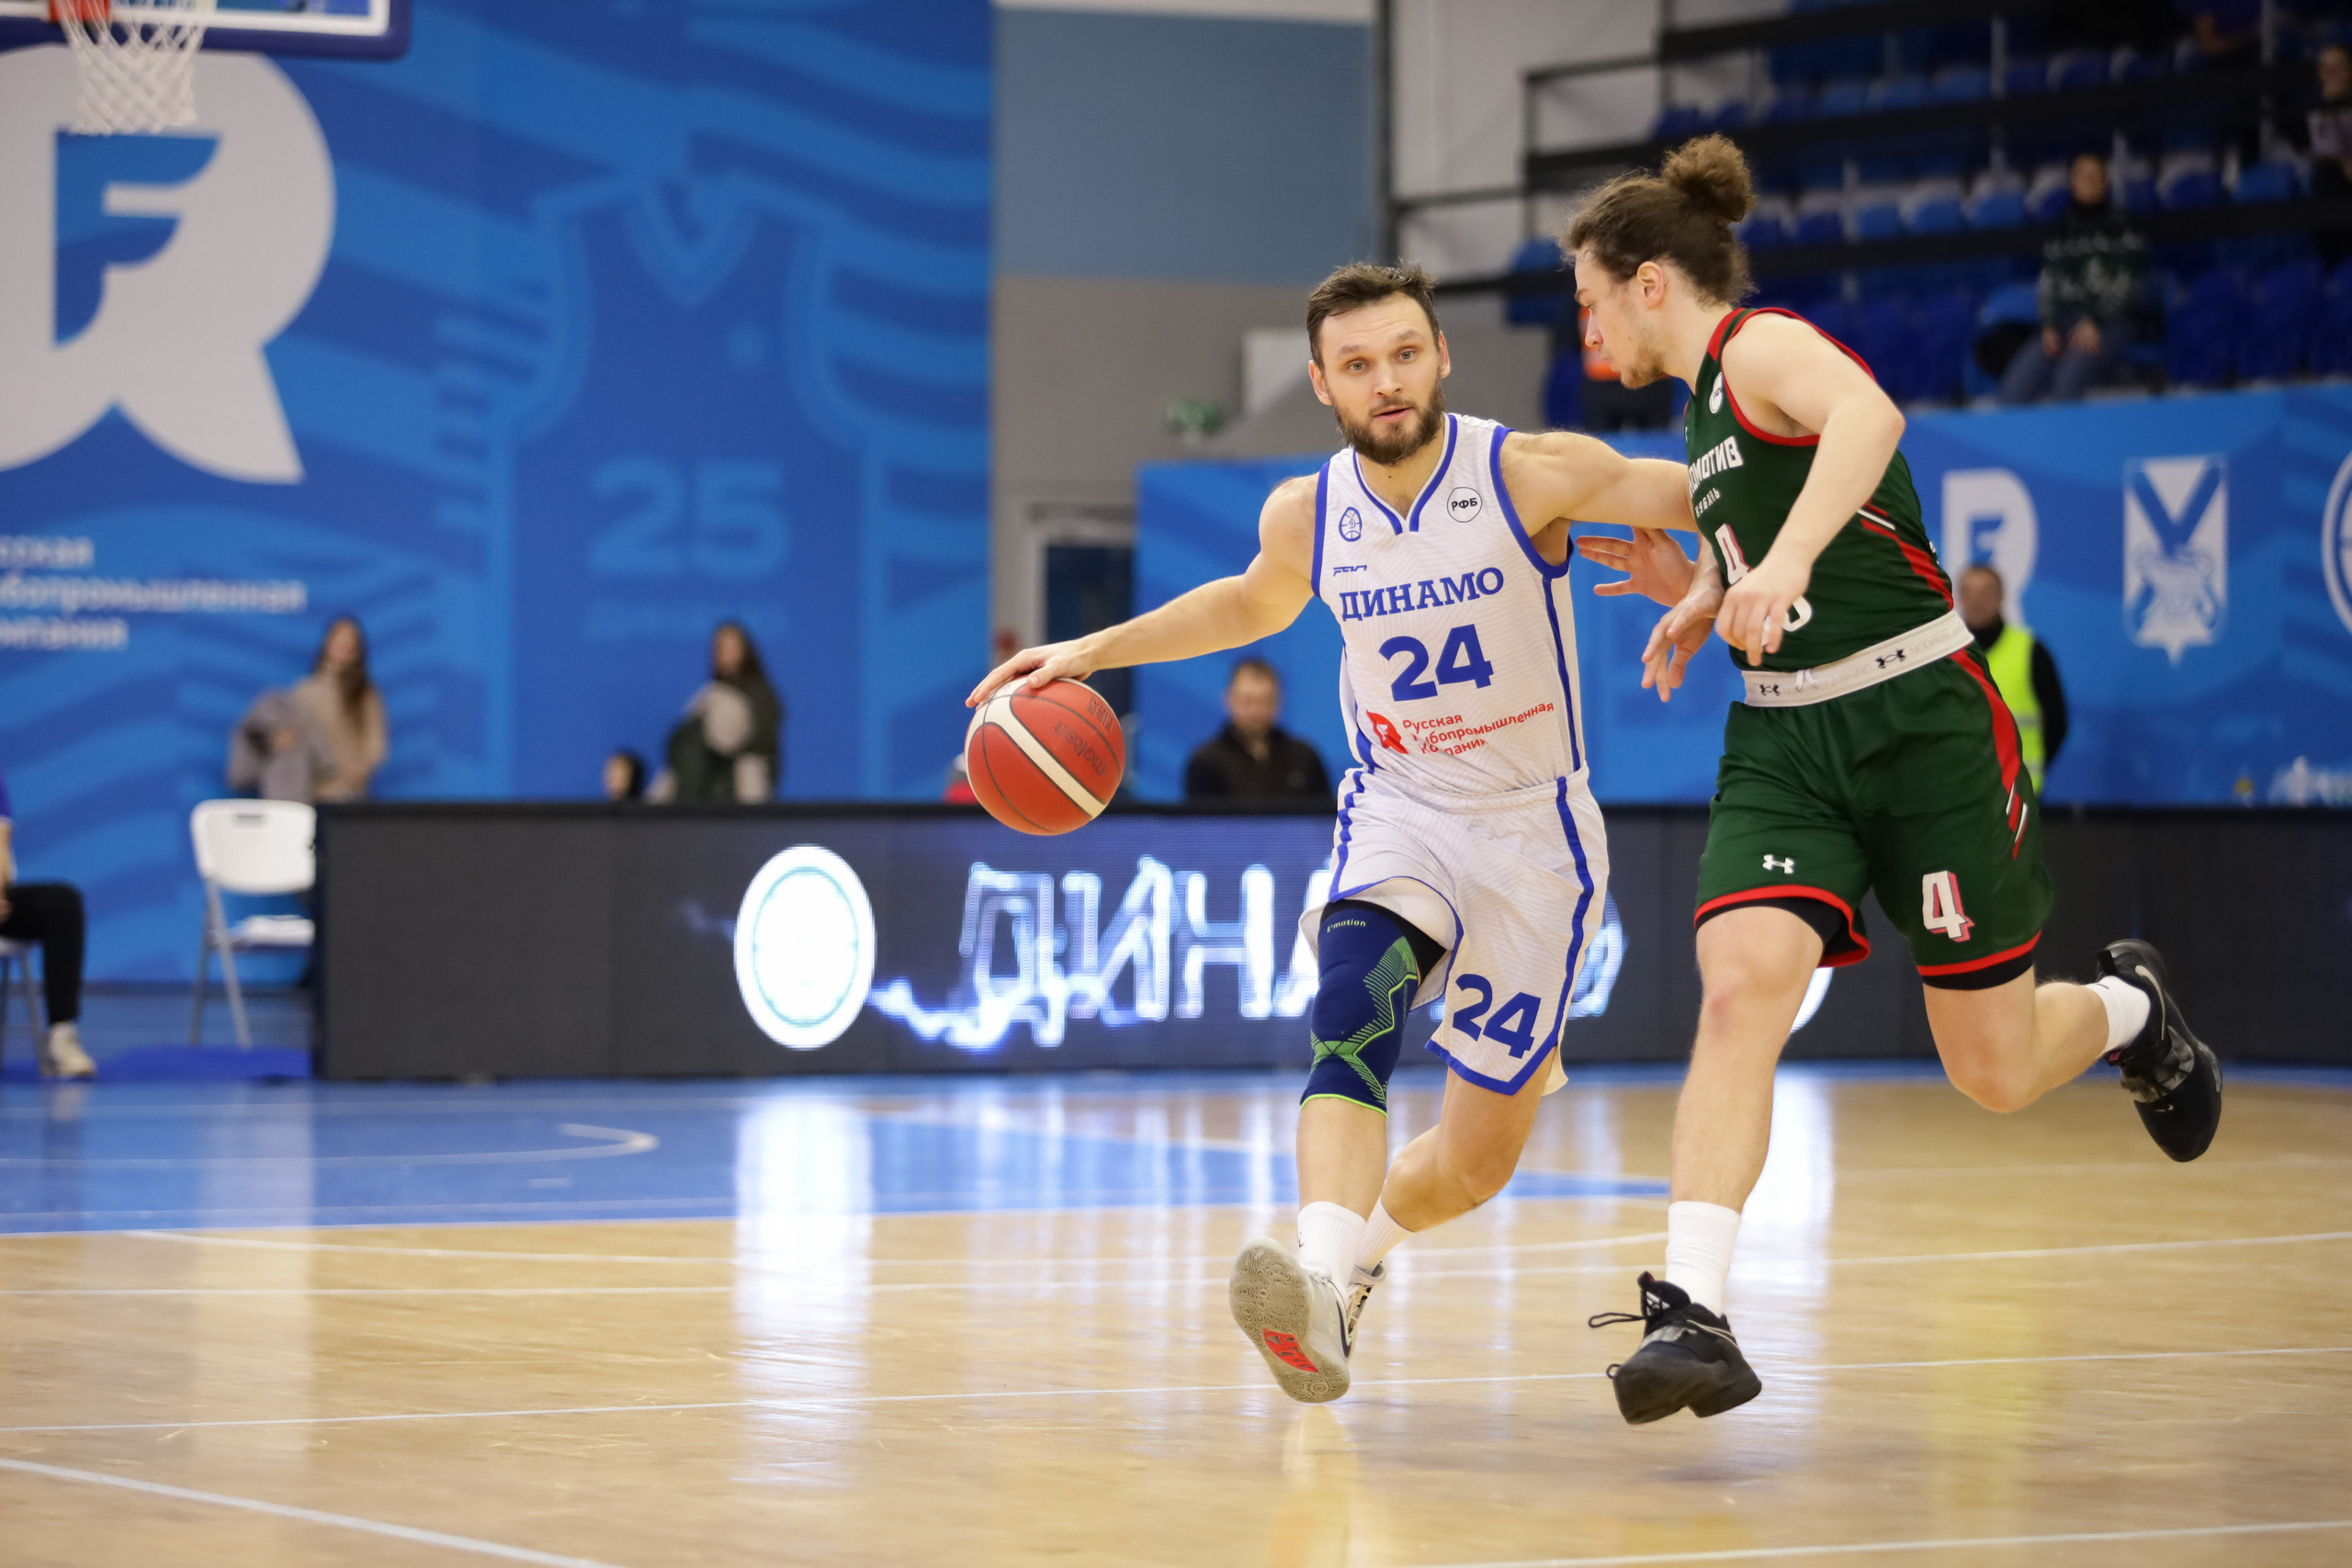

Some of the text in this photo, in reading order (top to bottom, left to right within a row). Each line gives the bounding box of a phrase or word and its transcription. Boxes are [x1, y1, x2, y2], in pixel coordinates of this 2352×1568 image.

[1689, 435, 1743, 499] ОМОТИВ
[591, 457, 790, 578] 25
[1451, 497, 1478, 512] РФБ
[1339, 567, 1504, 622] ДИНАМО
[1378, 624, 1494, 702] 24
[1055, 721, 1107, 776] molten
[1402, 715, 1463, 734] Русская
[1411, 703, 1555, 745] бопромышленная
[1922, 870, 1975, 942] 4
[1452, 973, 1542, 1060] 24
